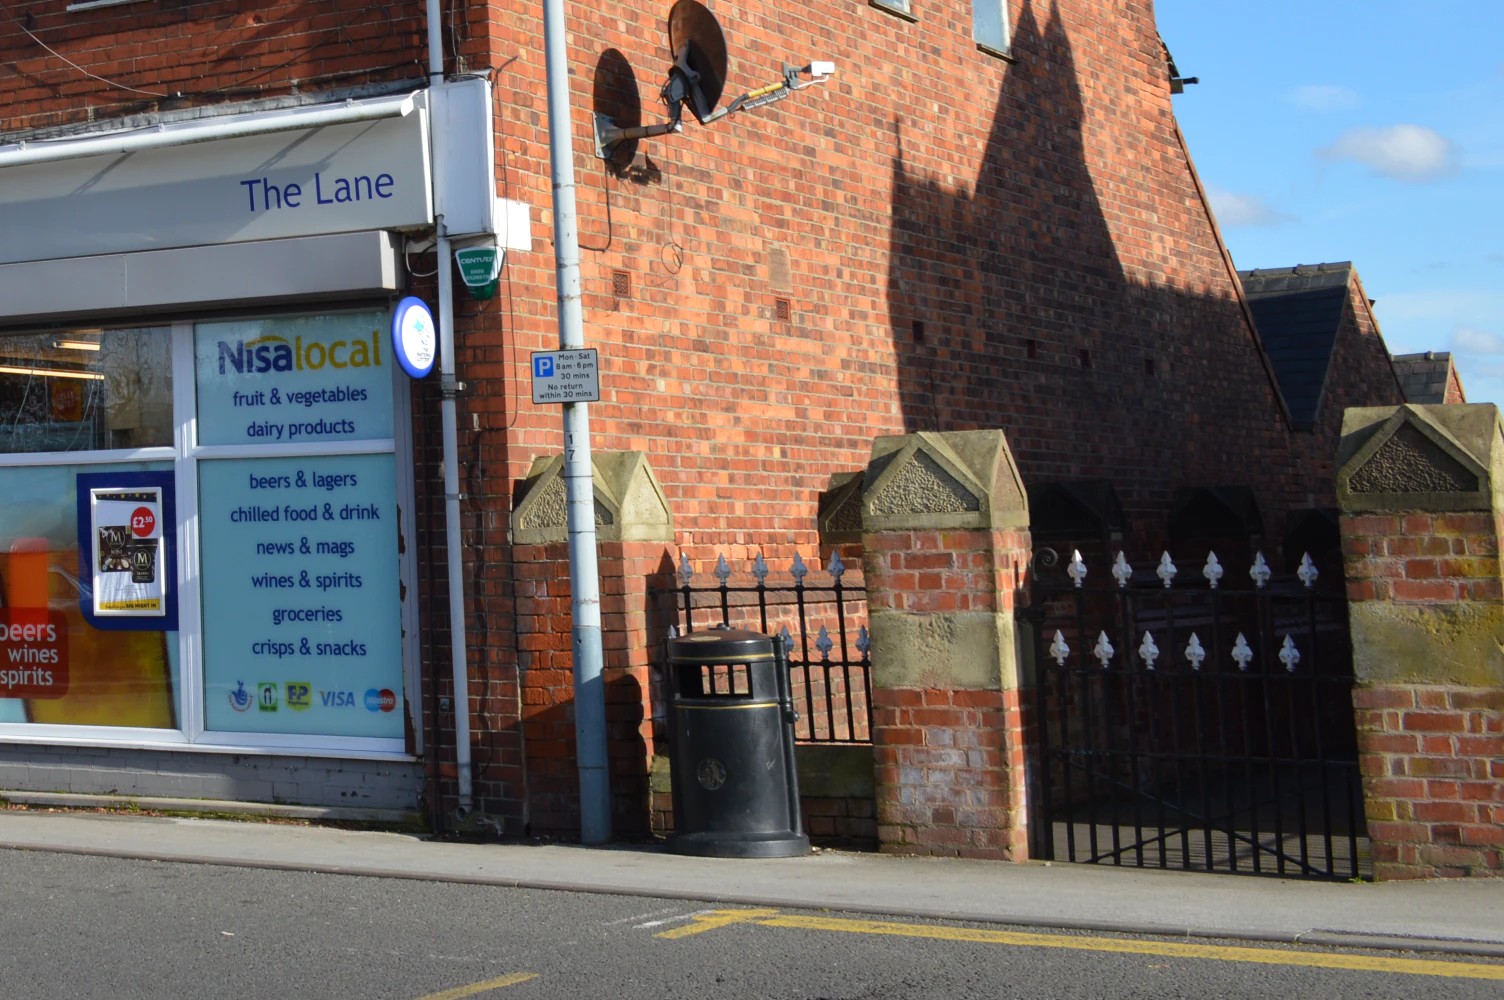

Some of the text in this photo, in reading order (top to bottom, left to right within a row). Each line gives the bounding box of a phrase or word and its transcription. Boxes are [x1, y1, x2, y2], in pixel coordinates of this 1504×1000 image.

[240, 173, 394, 211] The Lane
[461, 256, 493, 264] CENTURY
[218, 330, 382, 375] Nisa local
[233, 386, 368, 407] fruit & vegetables
[247, 419, 355, 440] dairy products
[250, 470, 357, 491] beers & lagers
[230, 503, 380, 522] chilled food & drink
[257, 537, 355, 558] news & mags
[251, 570, 362, 591] wines & spirits
[272, 606, 342, 625] groceries
[7, 644, 59, 663] wines
[252, 637, 367, 658] crisps & snacks
[0, 666, 53, 689] spirits
[318, 690, 355, 707] VISA
[366, 696, 394, 705] Maestro
